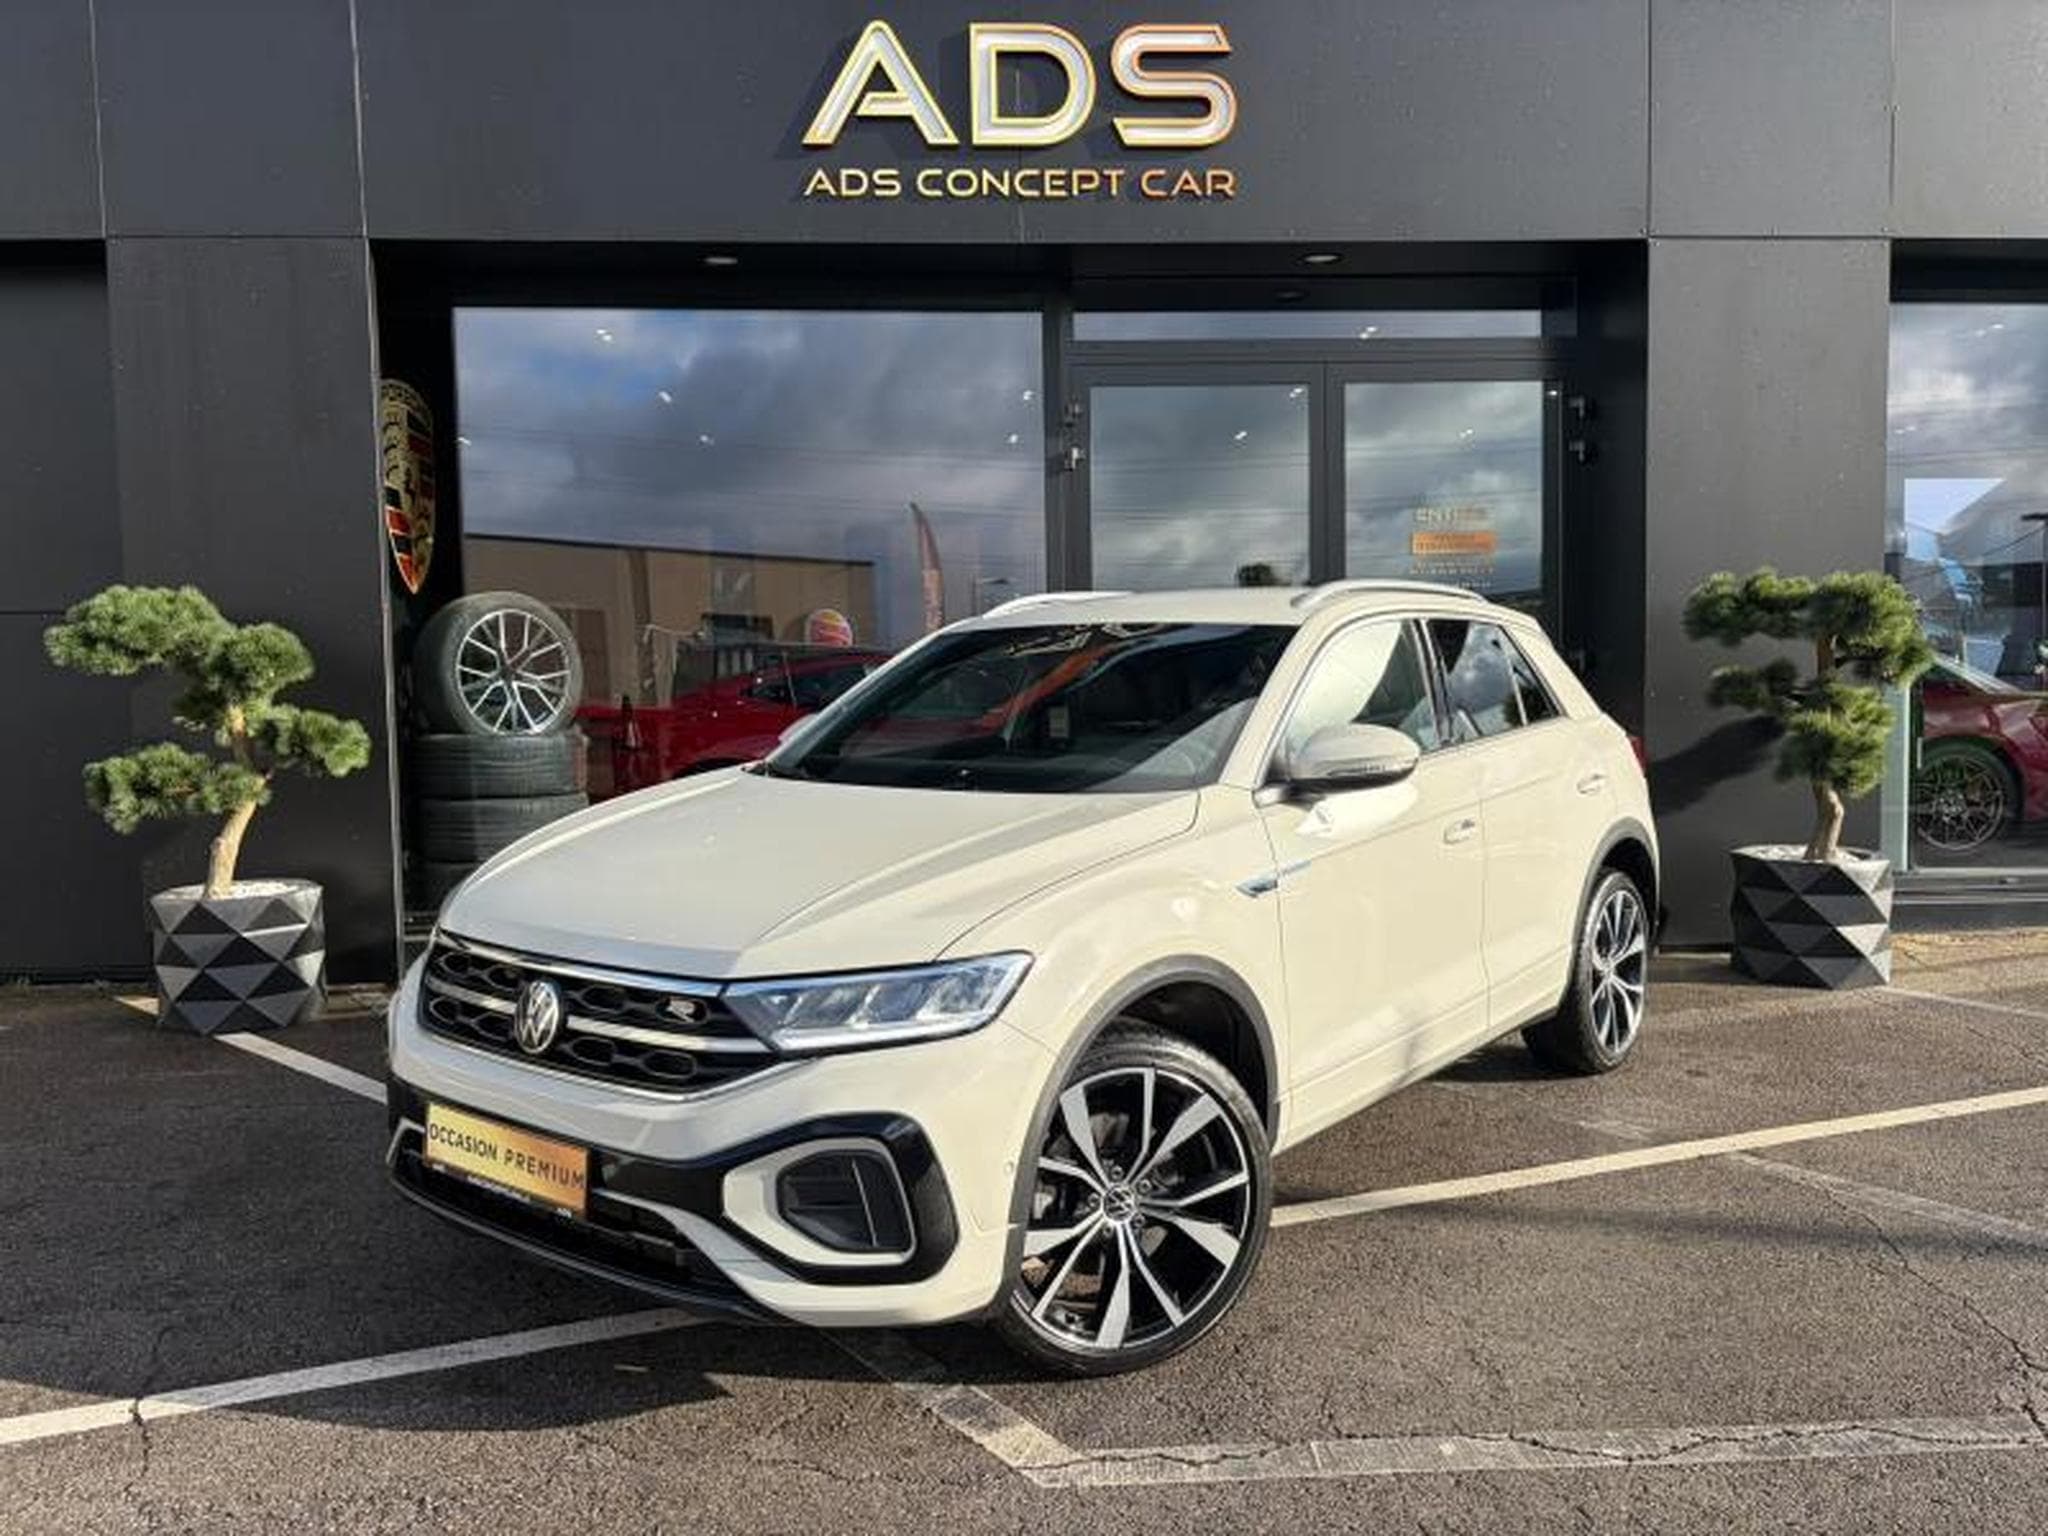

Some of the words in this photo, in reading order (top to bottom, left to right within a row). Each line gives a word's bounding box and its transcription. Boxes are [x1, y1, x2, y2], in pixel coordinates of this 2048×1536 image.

[802, 19, 1238, 147] ADS
[803, 168, 901, 197] ADS
[916, 168, 1125, 197] CONCEPT
[1140, 168, 1237, 197] CAR
[429, 1122, 498, 1161] OCCASION
[503, 1148, 585, 1189] PREMIUM
